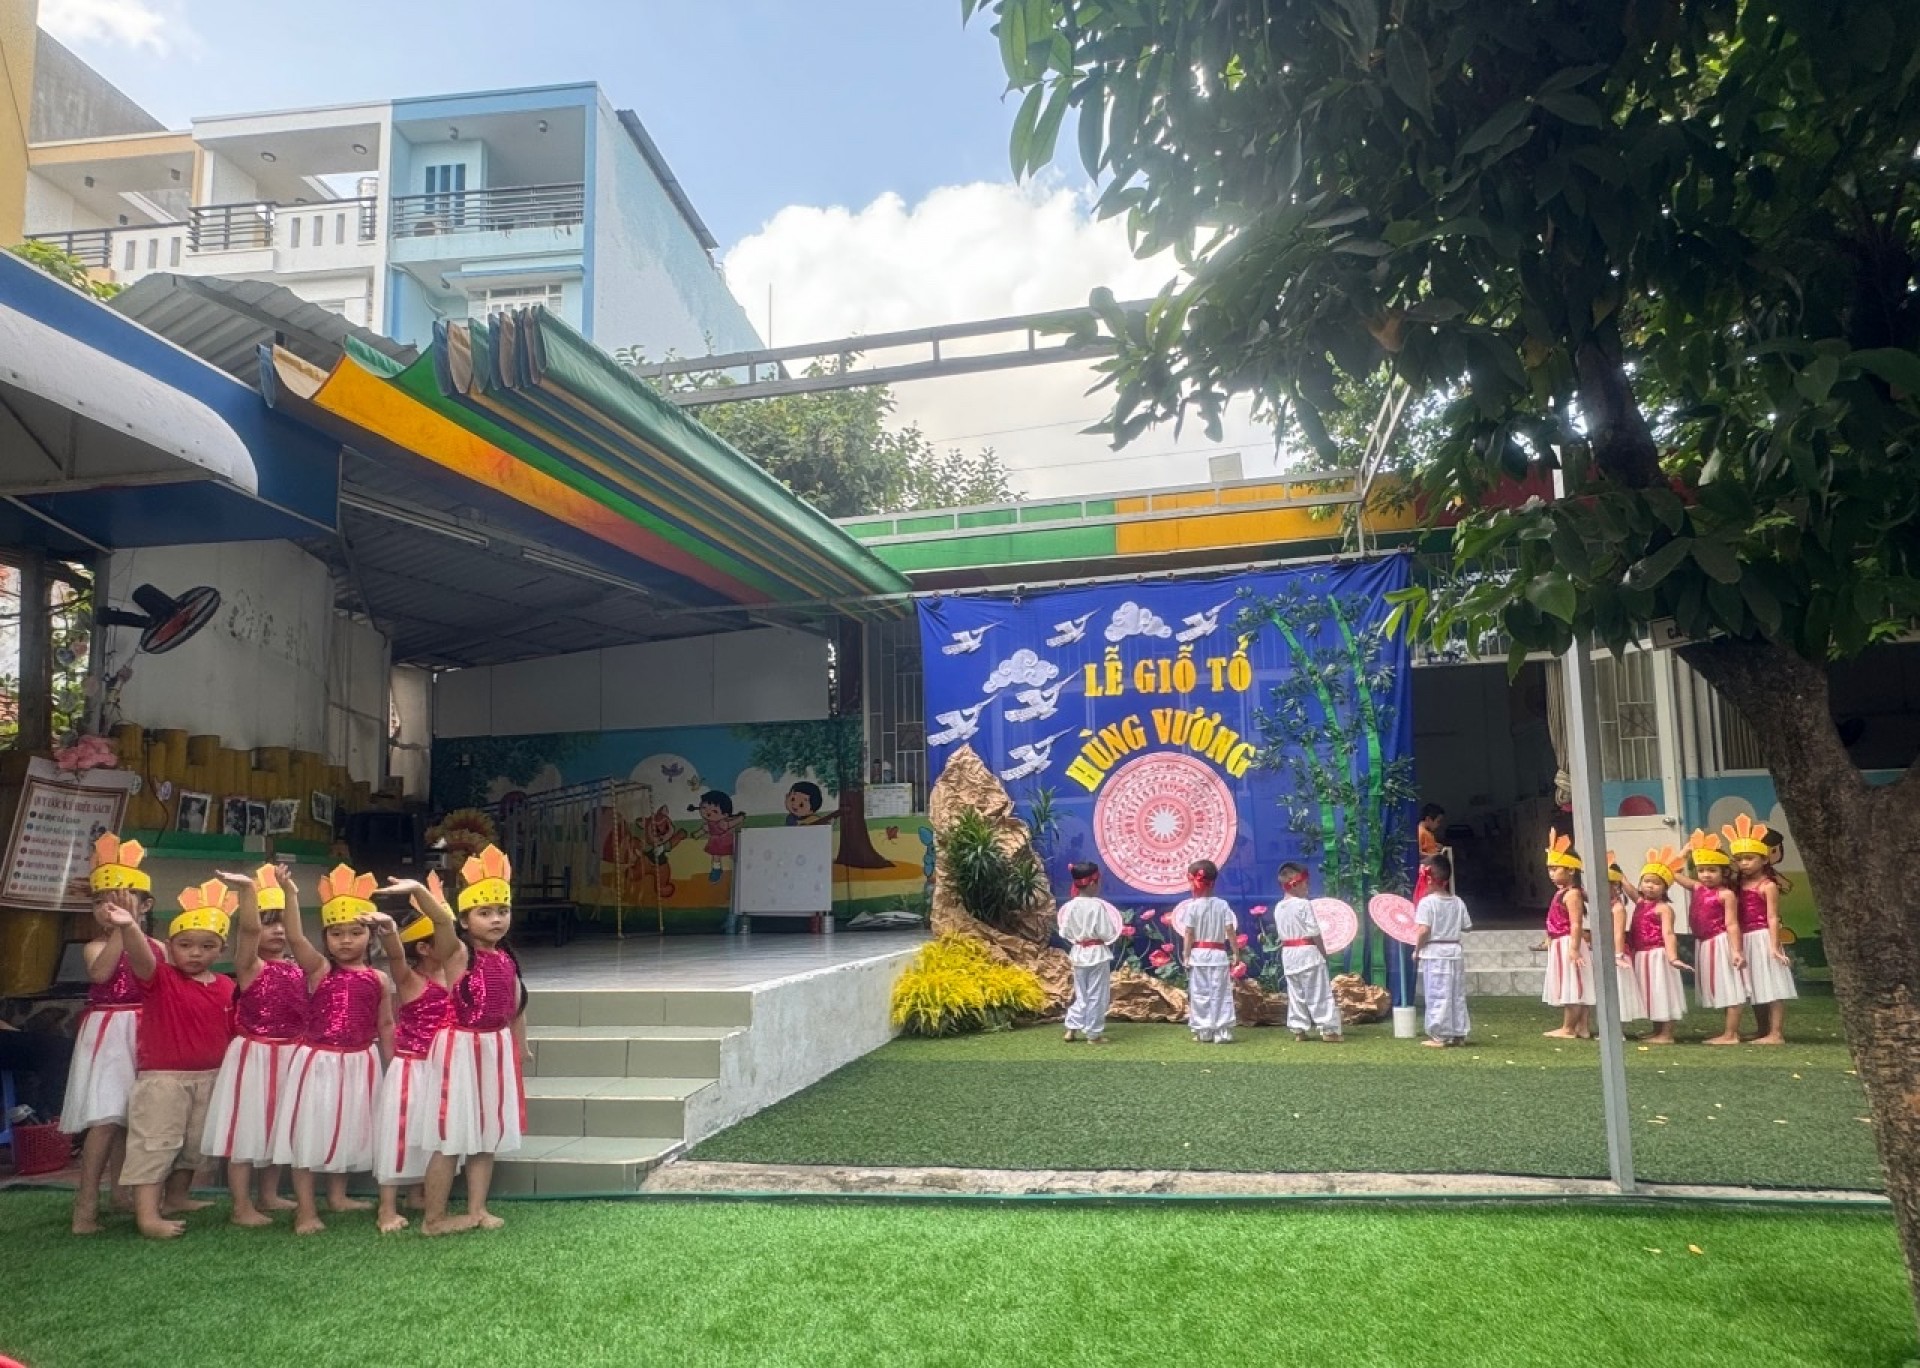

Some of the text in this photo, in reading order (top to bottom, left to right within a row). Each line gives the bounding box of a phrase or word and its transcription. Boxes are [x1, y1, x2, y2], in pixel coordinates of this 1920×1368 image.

[1084, 634, 1252, 697] LỄ GIỖ TỔ
[1065, 706, 1256, 793] HÙNG VƯƠNG
